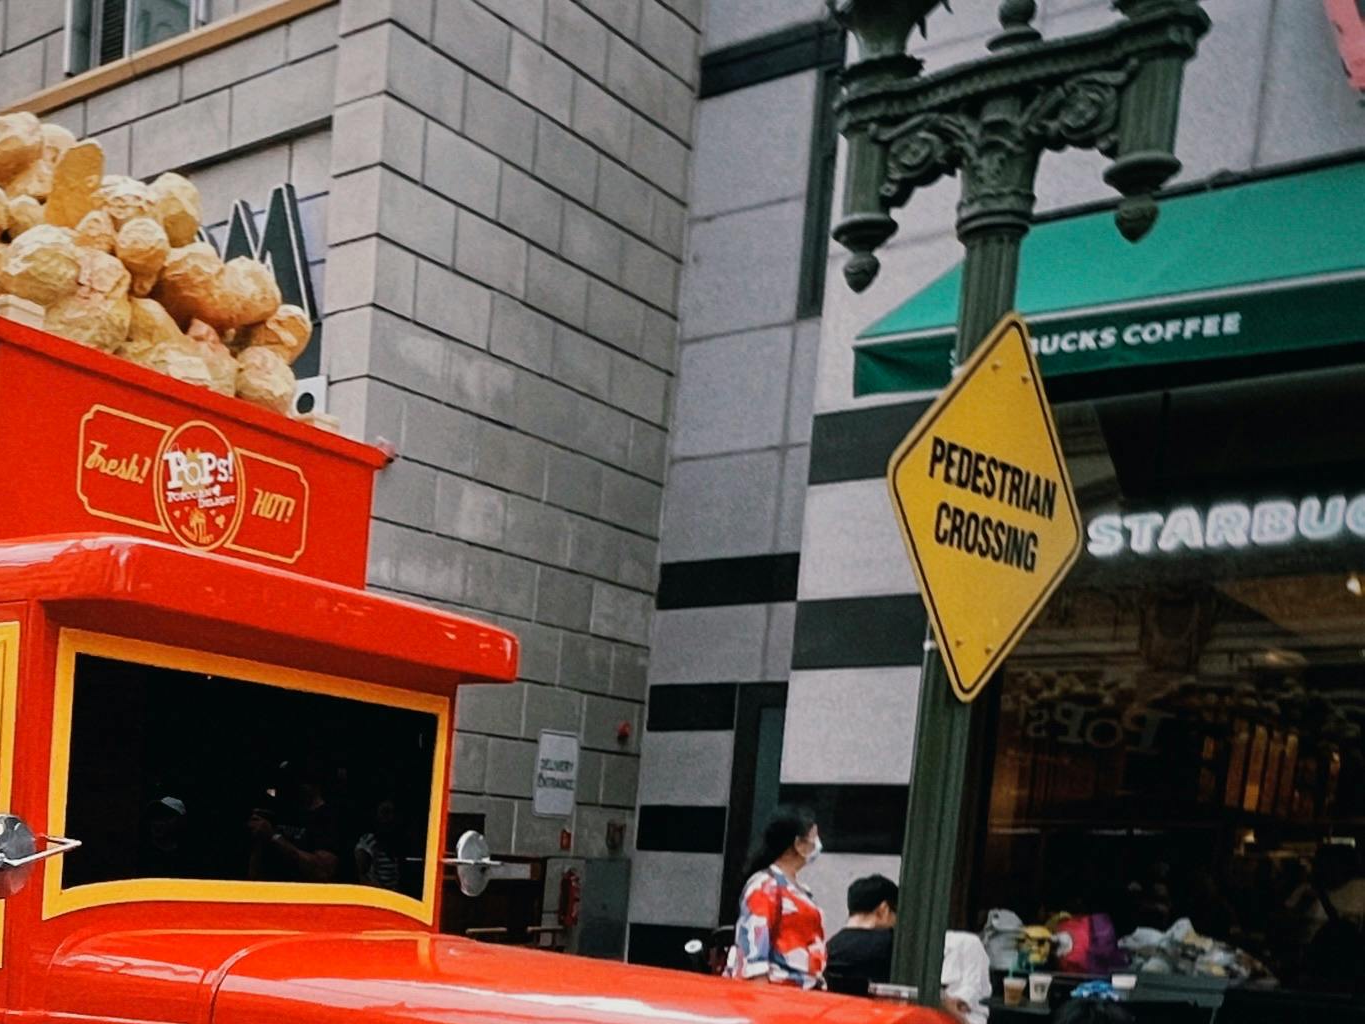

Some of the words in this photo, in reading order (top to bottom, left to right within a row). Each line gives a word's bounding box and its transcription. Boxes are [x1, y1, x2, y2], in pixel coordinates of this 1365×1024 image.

[1123, 312, 1242, 346] COFFEE
[929, 436, 1056, 521] PEDESTRIAN
[935, 502, 1038, 572] CROSSING
